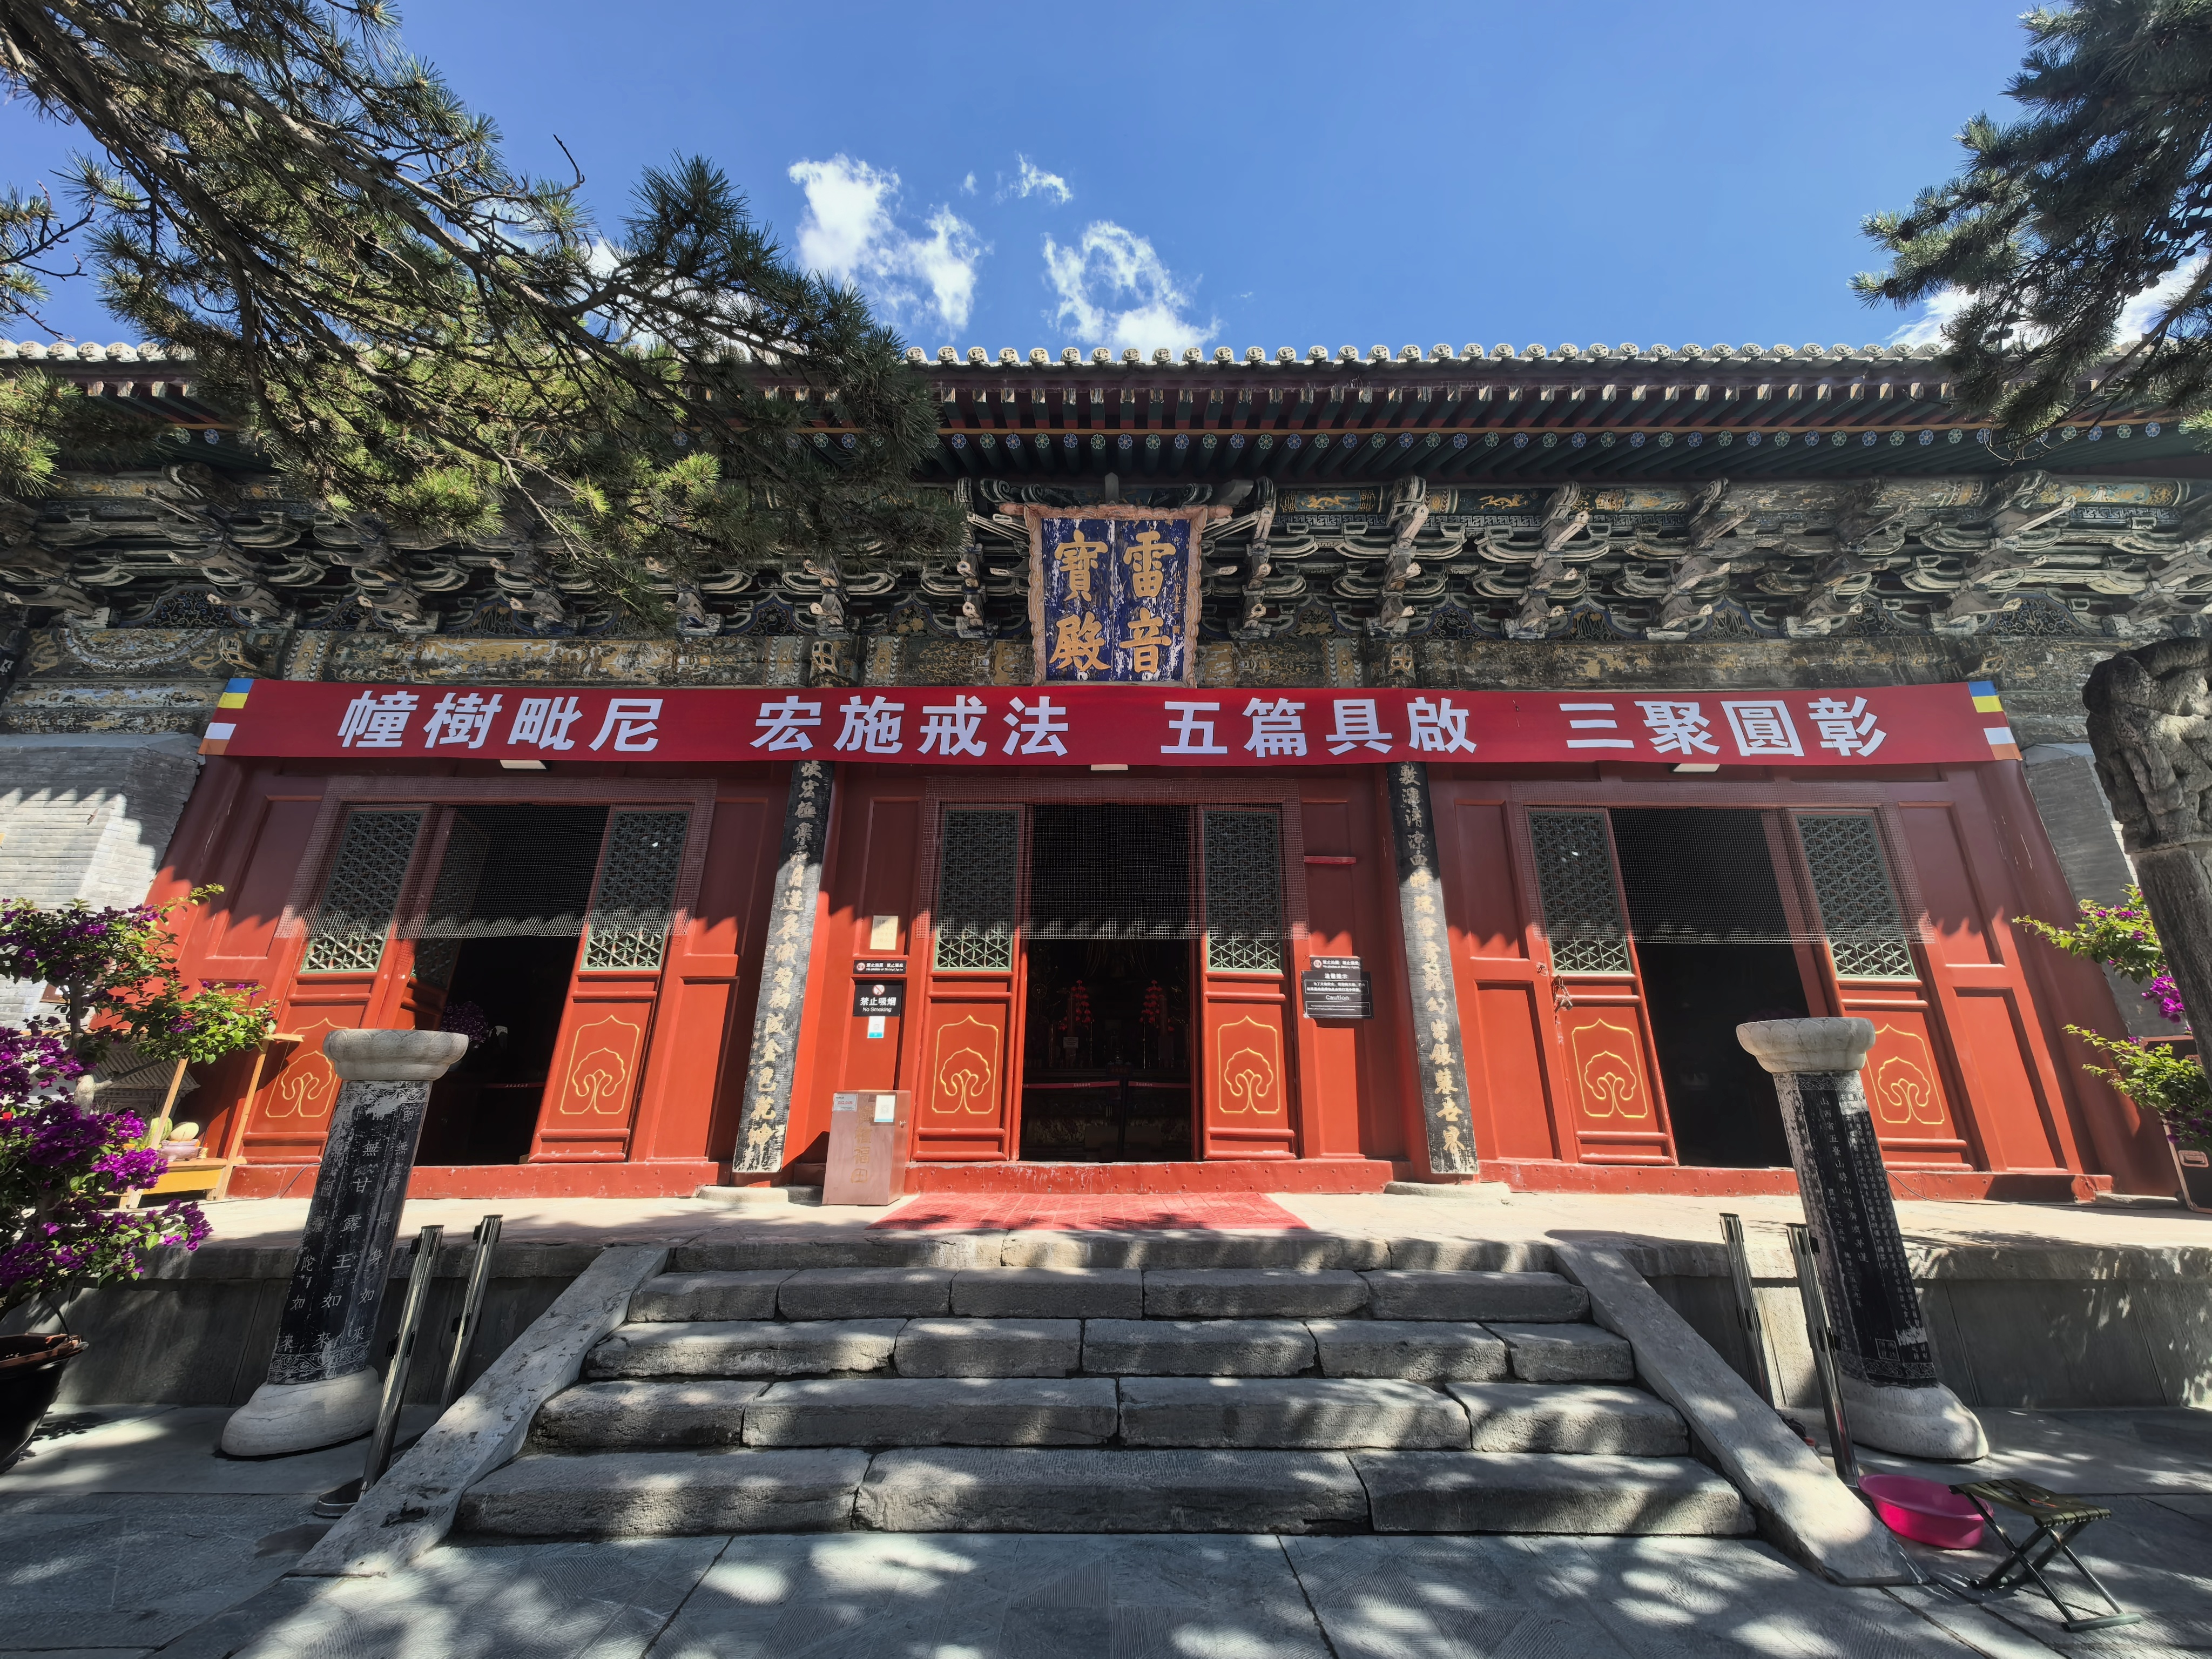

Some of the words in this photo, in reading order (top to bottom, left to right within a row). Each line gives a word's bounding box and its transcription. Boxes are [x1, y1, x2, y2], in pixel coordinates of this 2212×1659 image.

[1120, 530, 1176, 673] 雷音
[337, 690, 663, 752] 幢樹毗尼
[750, 695, 1069, 756] 宏施戒法
[1161, 697, 1478, 757] 五篇具啟
[1559, 696, 1887, 757] 三聚圓彰
[860, 996, 896, 1006] 禁止吸烟
